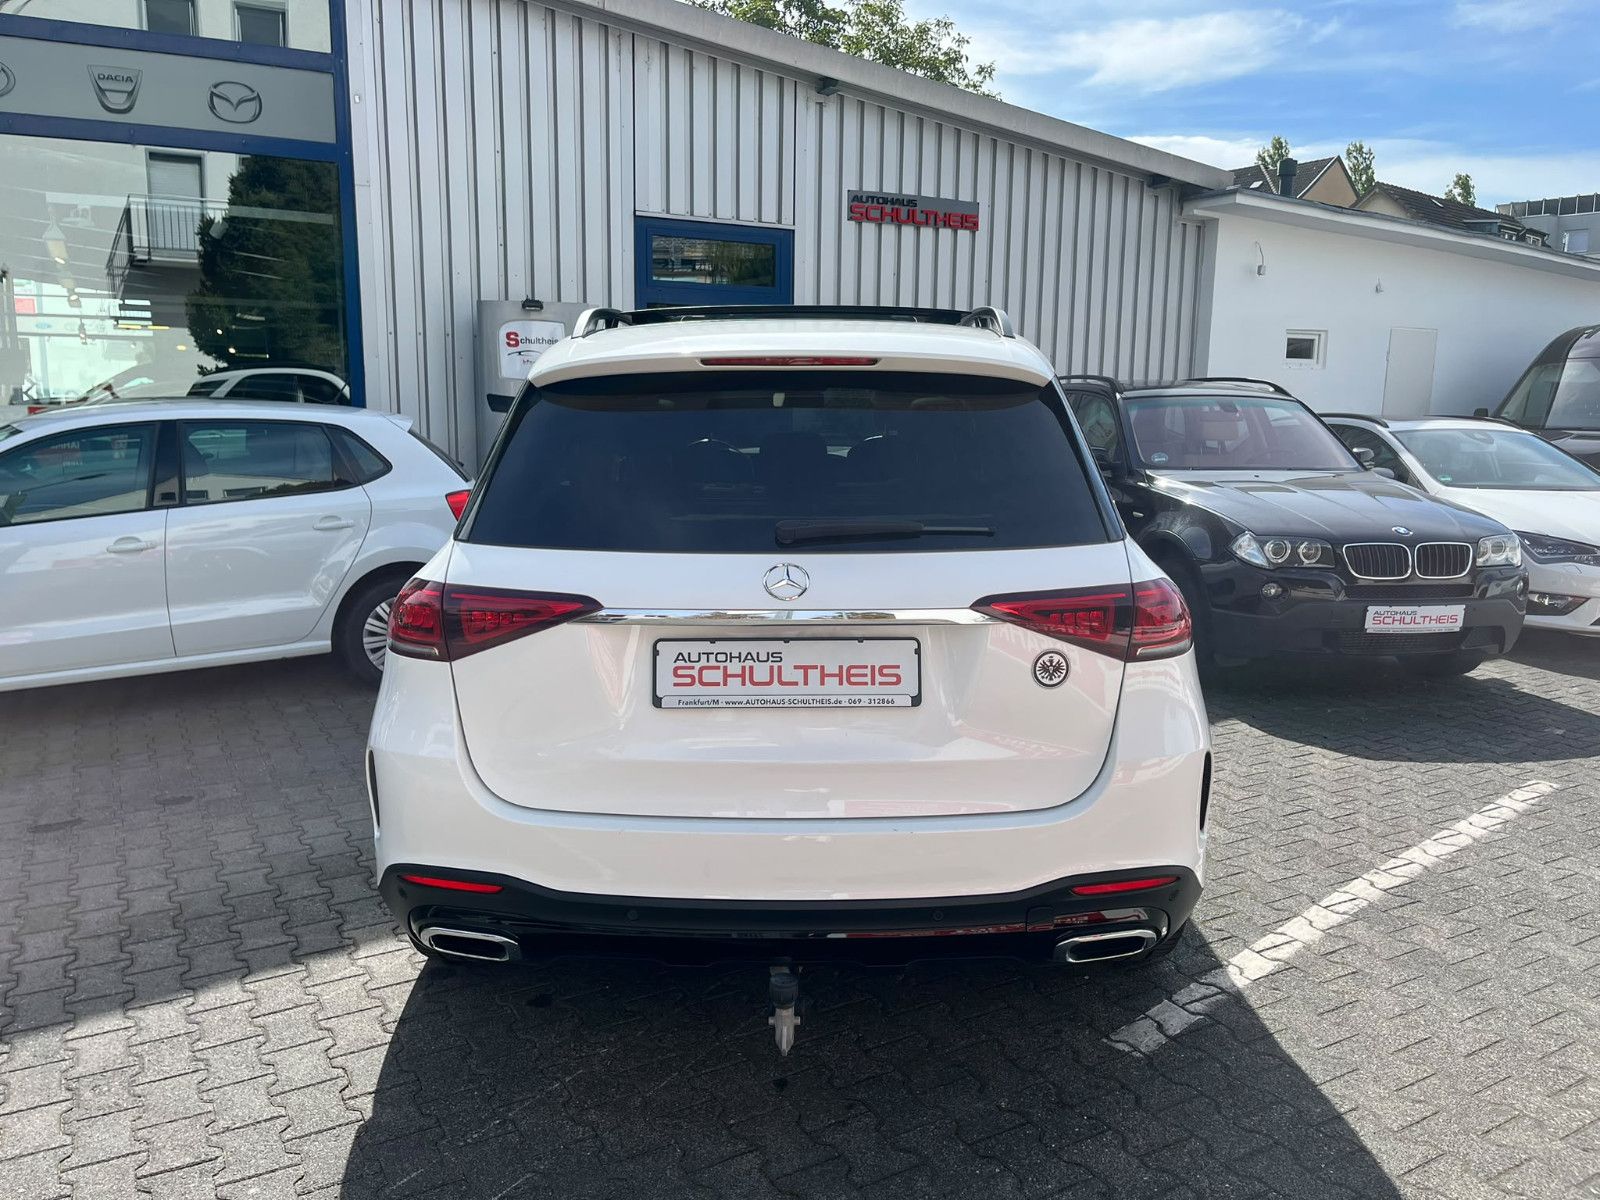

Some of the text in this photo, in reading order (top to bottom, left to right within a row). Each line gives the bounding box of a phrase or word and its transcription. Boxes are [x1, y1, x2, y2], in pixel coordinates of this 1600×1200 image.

[97, 73, 134, 83] DACIA
[852, 194, 918, 208] AUTOHAUS
[850, 203, 979, 232] SCHULTHEIS
[1372, 614, 1459, 625] SCHULTHEIS
[673, 651, 783, 663] AUTOHAUS
[672, 664, 902, 687] SCHULTHEIS
[677, 698, 720, 706] Frankfurt/M
[867, 697, 895, 705] 312866
